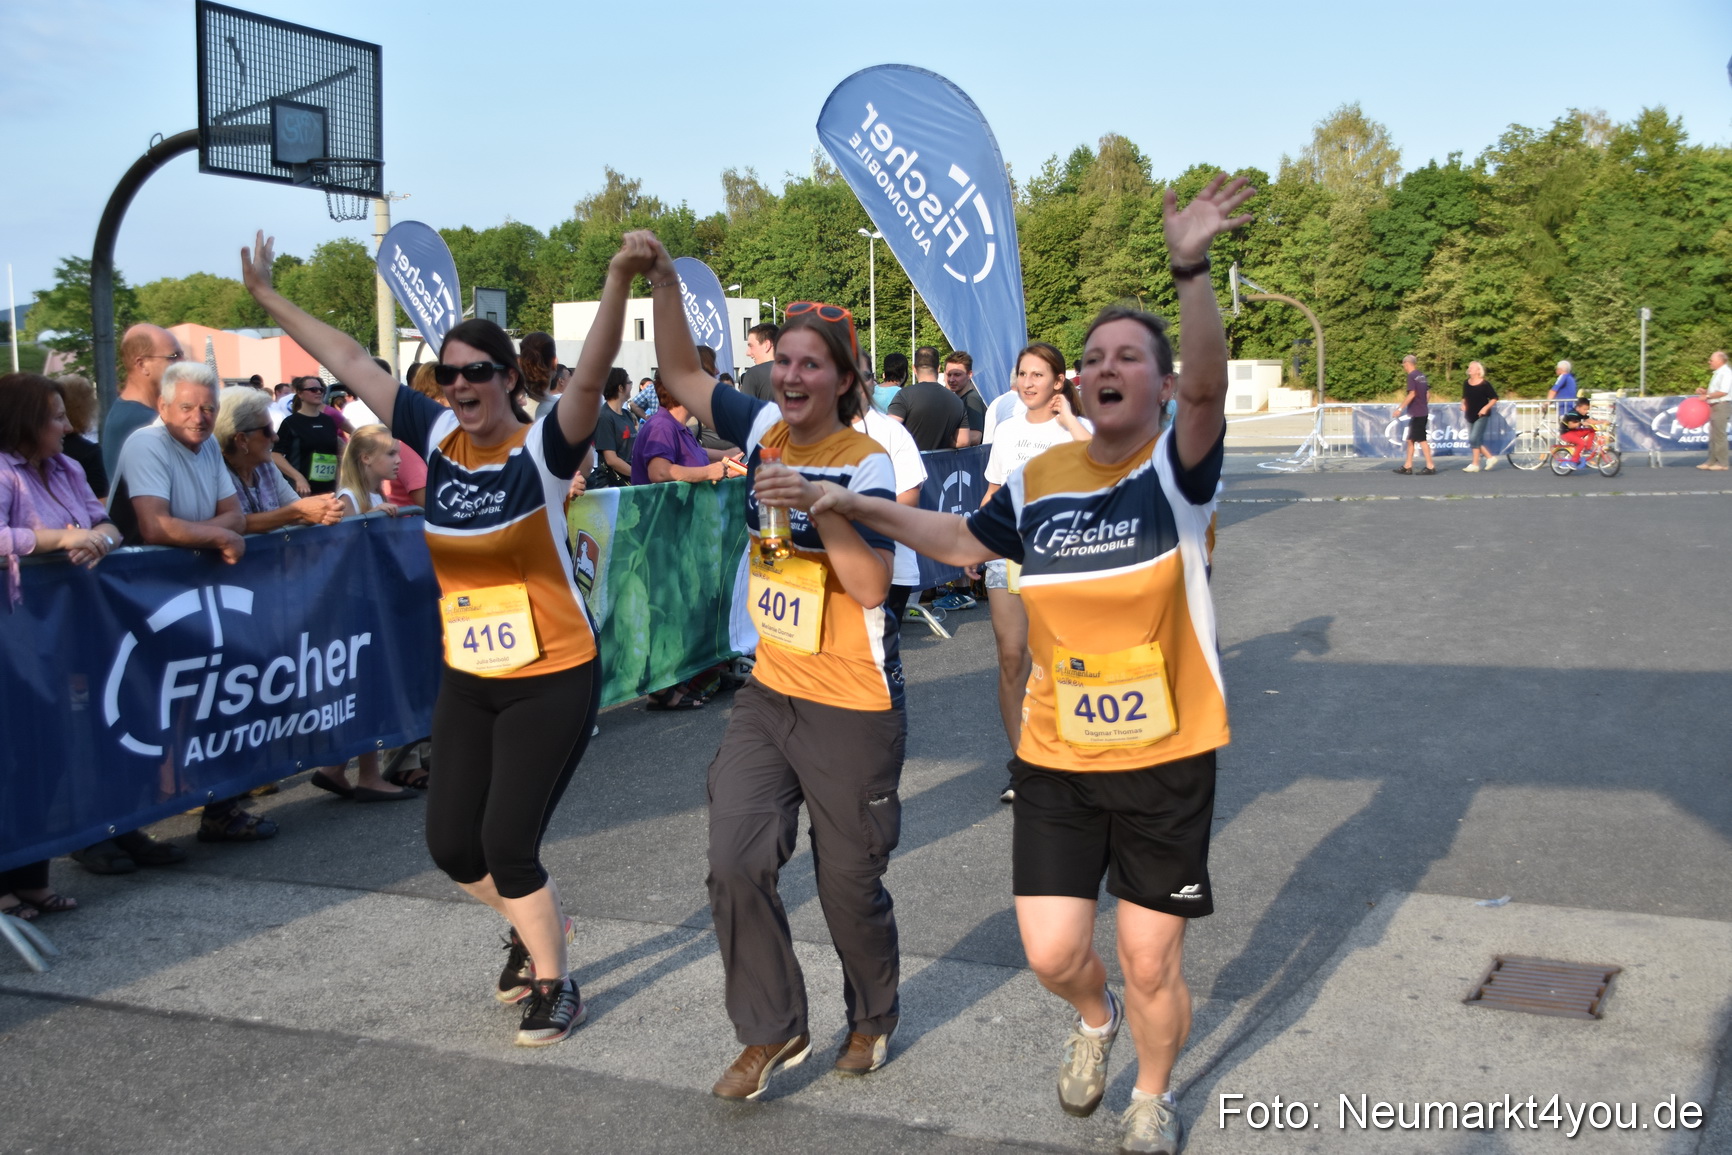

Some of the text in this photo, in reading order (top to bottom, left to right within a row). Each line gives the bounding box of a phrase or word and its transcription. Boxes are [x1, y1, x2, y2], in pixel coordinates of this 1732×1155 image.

[1015, 439, 1031, 448] Alle
[315, 464, 336, 475] 1213
[1046, 518, 1140, 548] Fischer
[1051, 537, 1135, 558] AUTOMOBILE
[758, 587, 801, 626] 401
[463, 622, 516, 653] 416
[161, 631, 372, 730] Fischer
[1074, 690, 1147, 723] 402
[184, 693, 356, 767] AUTOMOBILE
[1084, 728, 1143, 737] Dagmar Thomas
